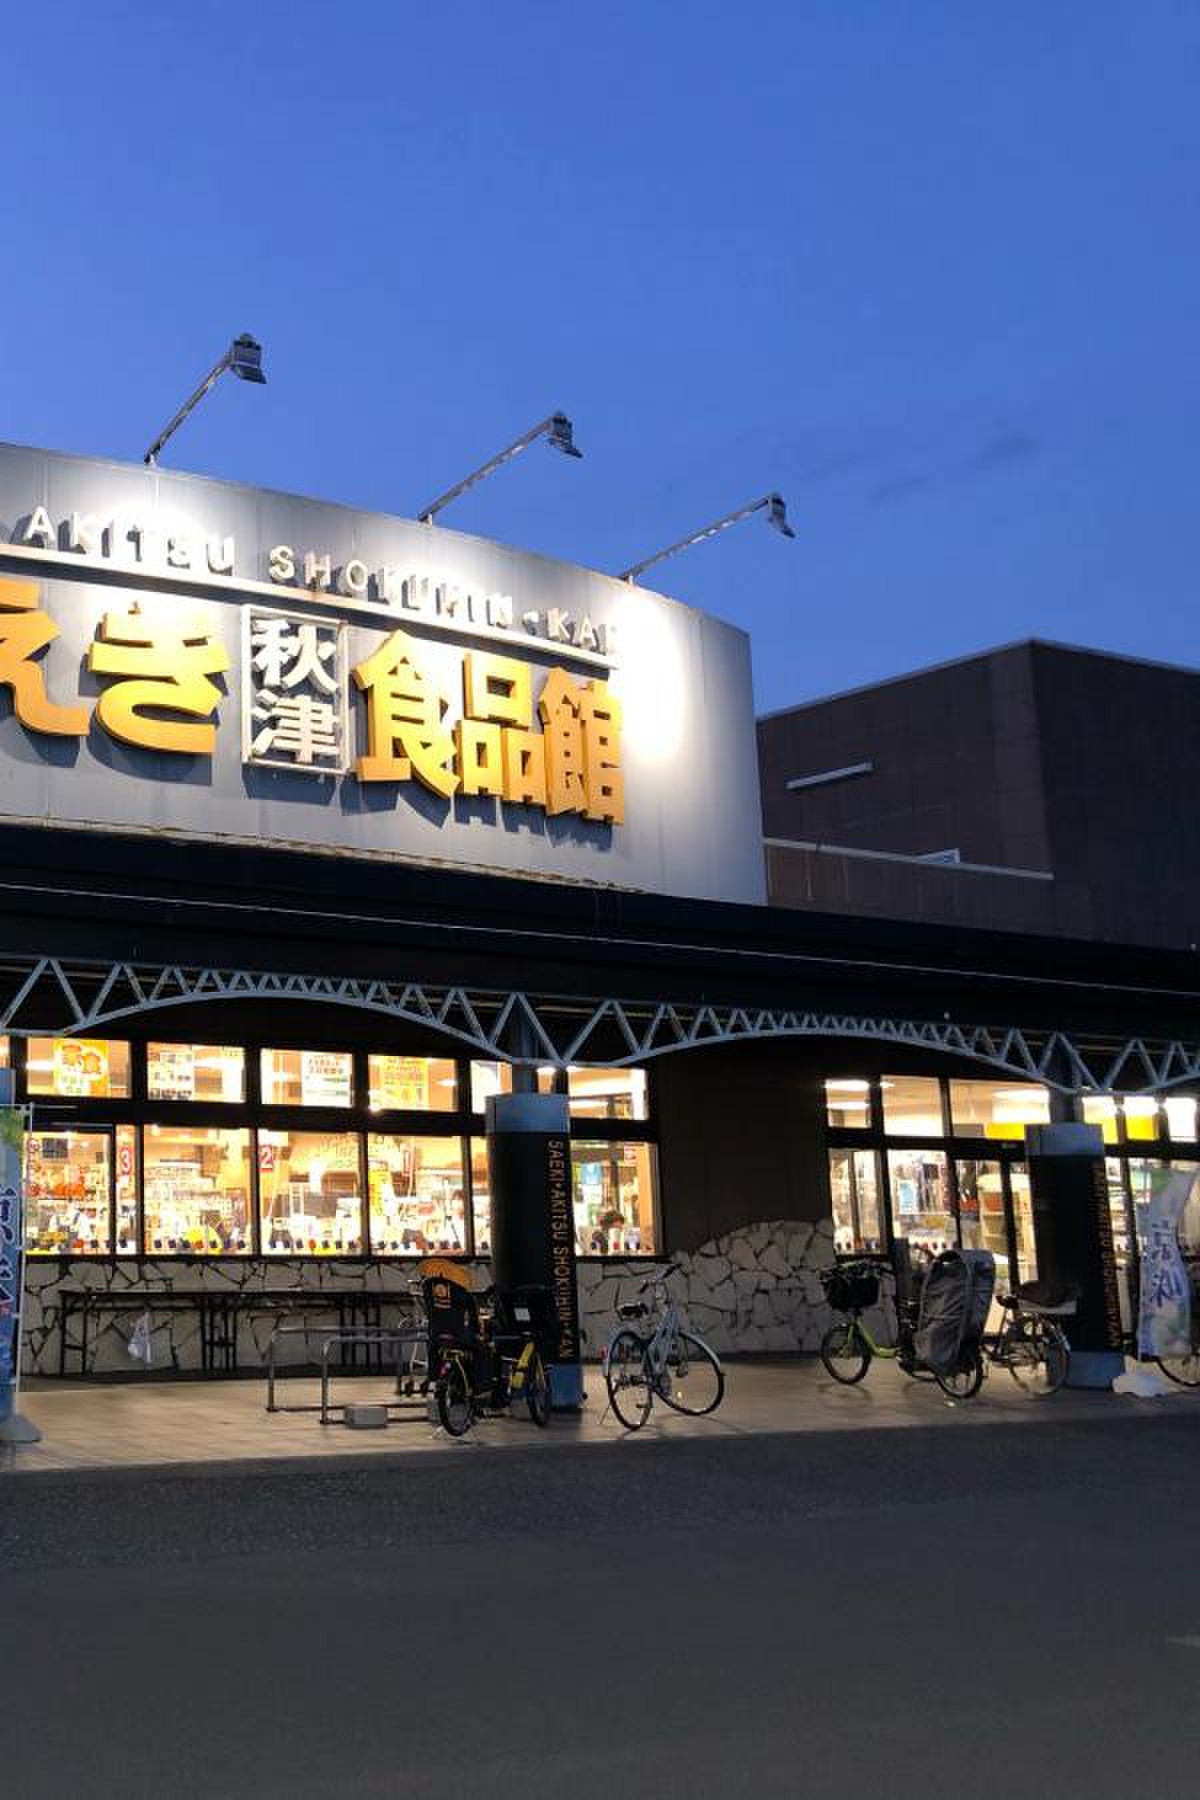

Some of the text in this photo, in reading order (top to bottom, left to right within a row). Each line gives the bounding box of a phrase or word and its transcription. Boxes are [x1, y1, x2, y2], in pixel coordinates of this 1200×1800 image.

[251, 617, 340, 764] 秋津
[352, 628, 625, 826] 食品館
[121, 1151, 130, 1171] 3
[260, 1149, 272, 1169] 2
